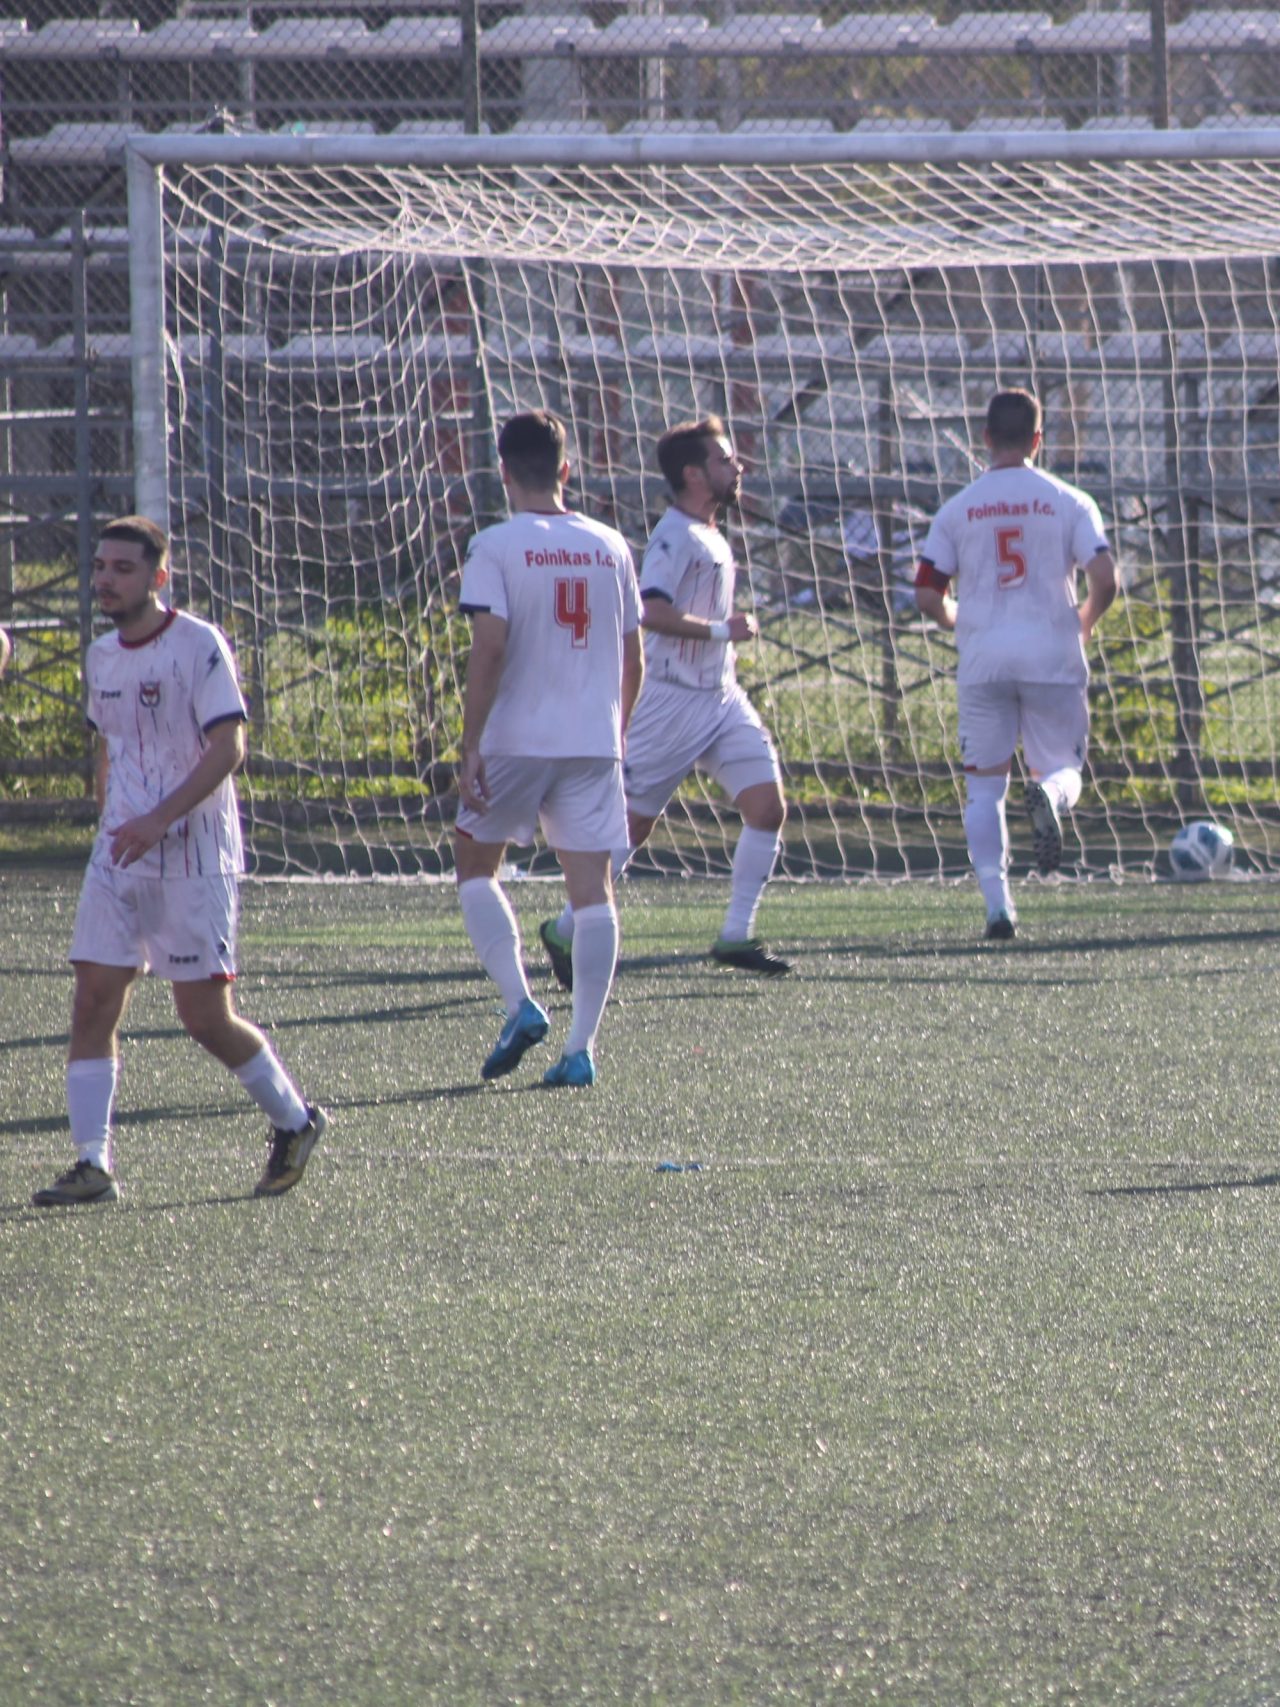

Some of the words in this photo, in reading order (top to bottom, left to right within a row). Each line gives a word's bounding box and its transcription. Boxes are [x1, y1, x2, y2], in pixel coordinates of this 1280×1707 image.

[967, 501, 1029, 522] Foinikas
[525, 549, 591, 567] Foinikas
[994, 526, 1027, 592] 5
[554, 577, 591, 649] 4
